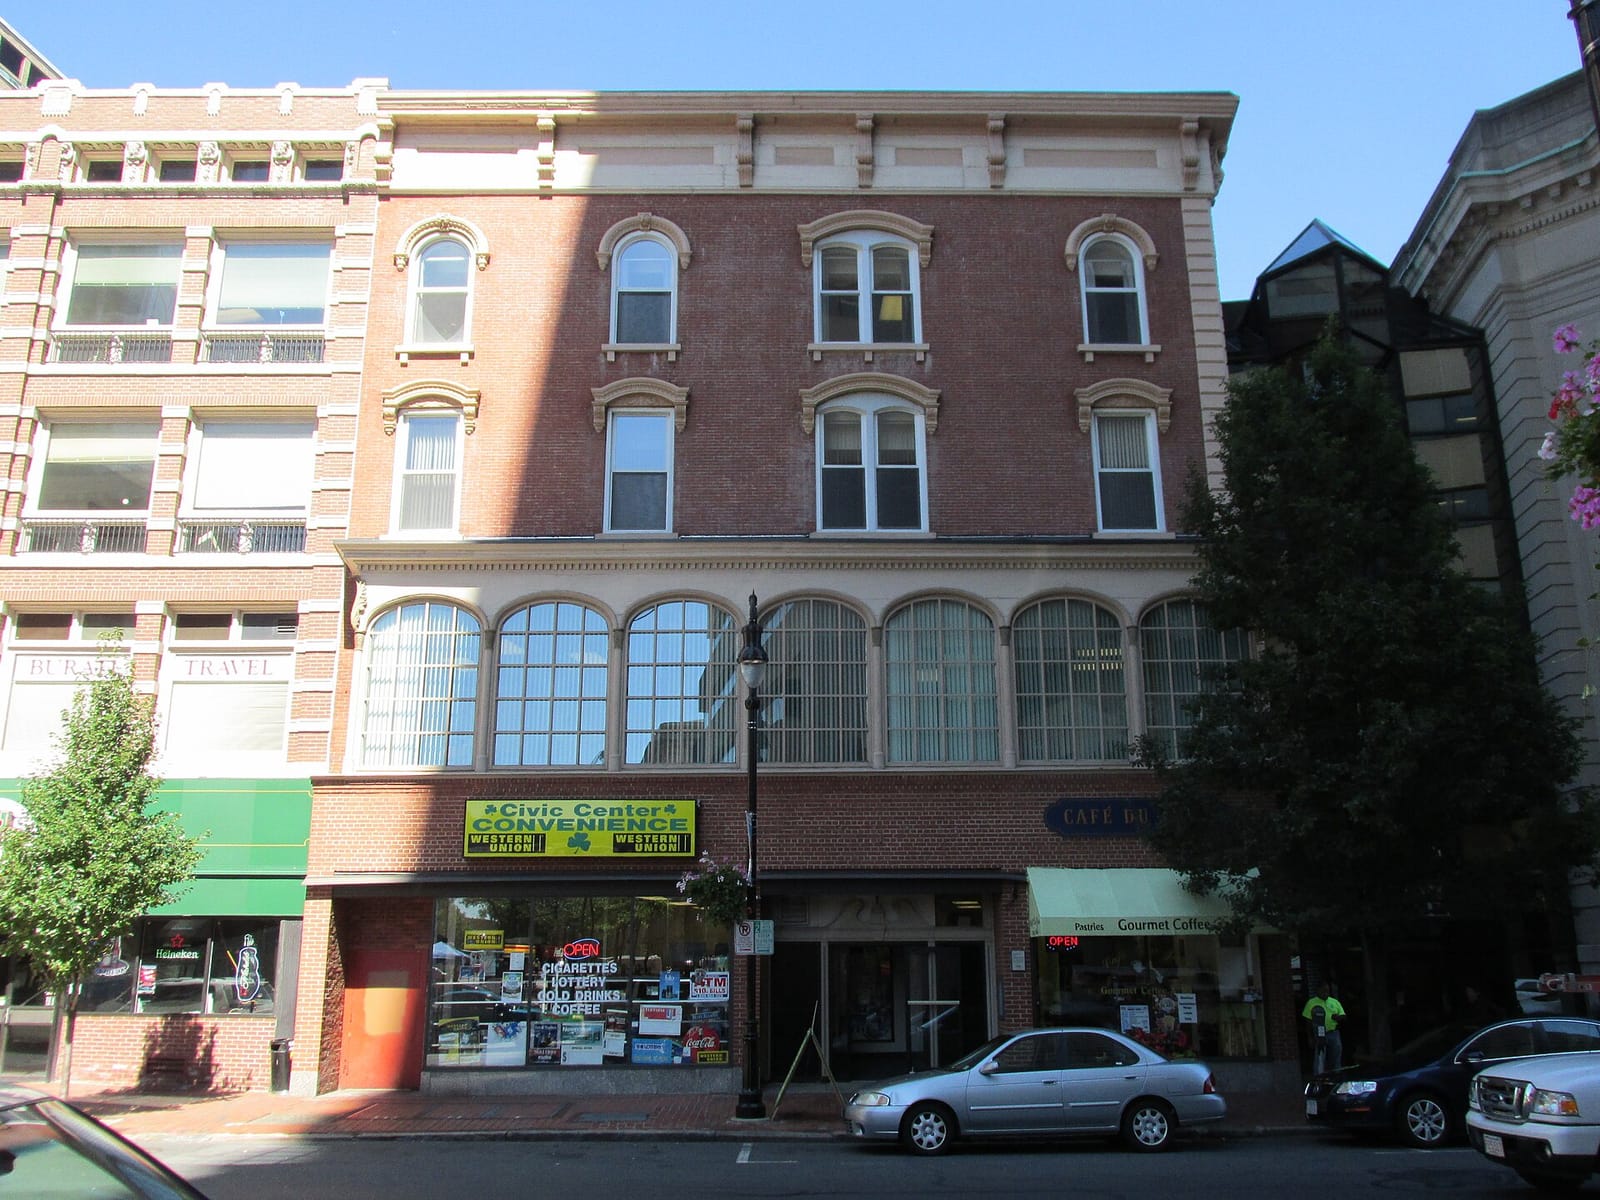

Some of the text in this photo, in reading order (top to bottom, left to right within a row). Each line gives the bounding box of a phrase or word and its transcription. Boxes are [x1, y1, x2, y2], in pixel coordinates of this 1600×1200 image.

[184, 659, 273, 676] TRAVEL
[499, 803, 661, 817] Civic Center
[1063, 805, 1149, 825] CAFÉ DU
[472, 818, 688, 832] CONVENIENCE
[470, 834, 532, 843] WESTERN
[615, 834, 678, 843] WESTERN
[489, 843, 532, 852] UNION
[634, 843, 678, 852] UNION
[1074, 917, 1211, 931] Pastries Gourmet Coffee
[1049, 936, 1079, 946] OPEN
[155, 949, 200, 959] Heineken
[563, 943, 600, 956] OPEN
[542, 962, 618, 974] CIGARETTES
[551, 976, 607, 988] LOTTERY
[537, 990, 621, 1001] COLD DRINKS
[552, 1003, 601, 1015] COFFEE
